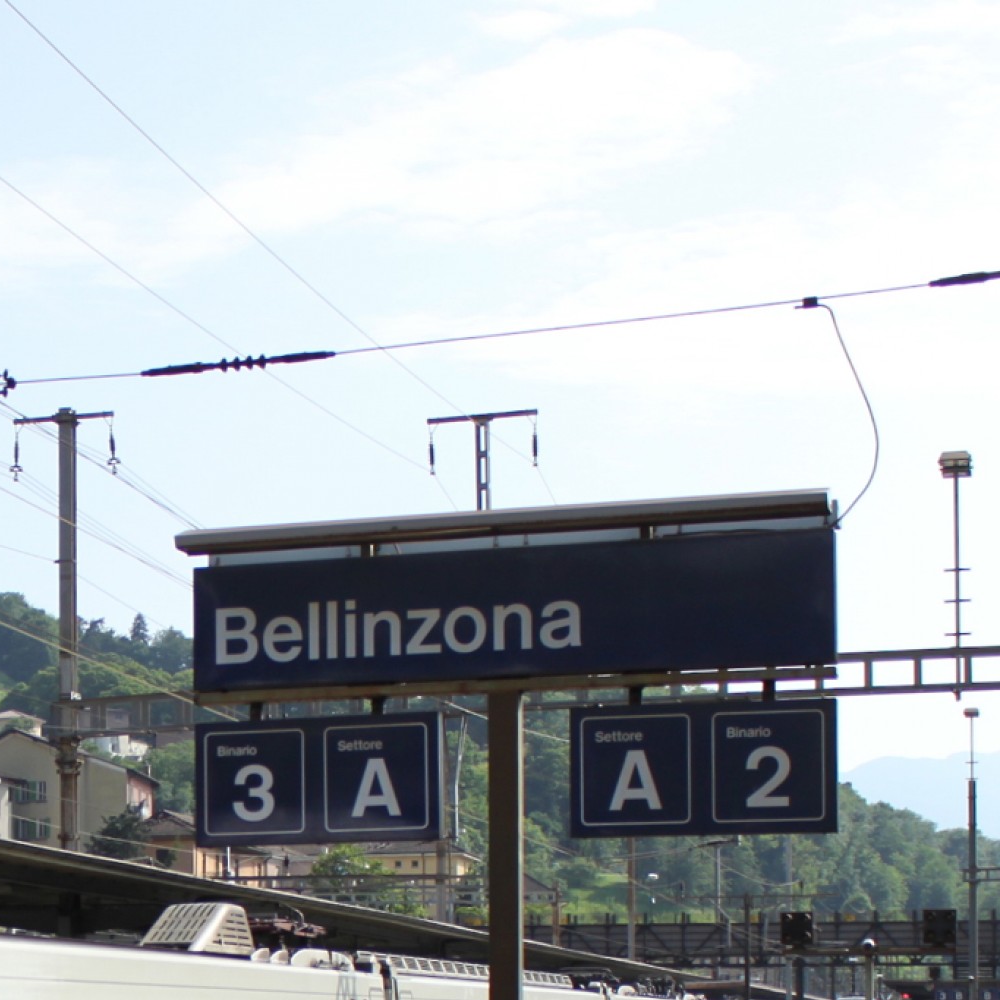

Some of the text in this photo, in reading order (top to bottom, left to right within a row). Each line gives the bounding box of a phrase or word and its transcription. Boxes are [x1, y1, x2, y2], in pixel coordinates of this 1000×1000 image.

[215, 599, 582, 665] Bellinzona
[216, 745, 257, 757] Binario
[337, 740, 383, 752] Settore
[594, 730, 643, 743] Settore
[726, 726, 771, 739] Binario
[232, 764, 275, 822] 3
[351, 758, 402, 817] A
[609, 750, 663, 811] A
[746, 745, 791, 807] 2
